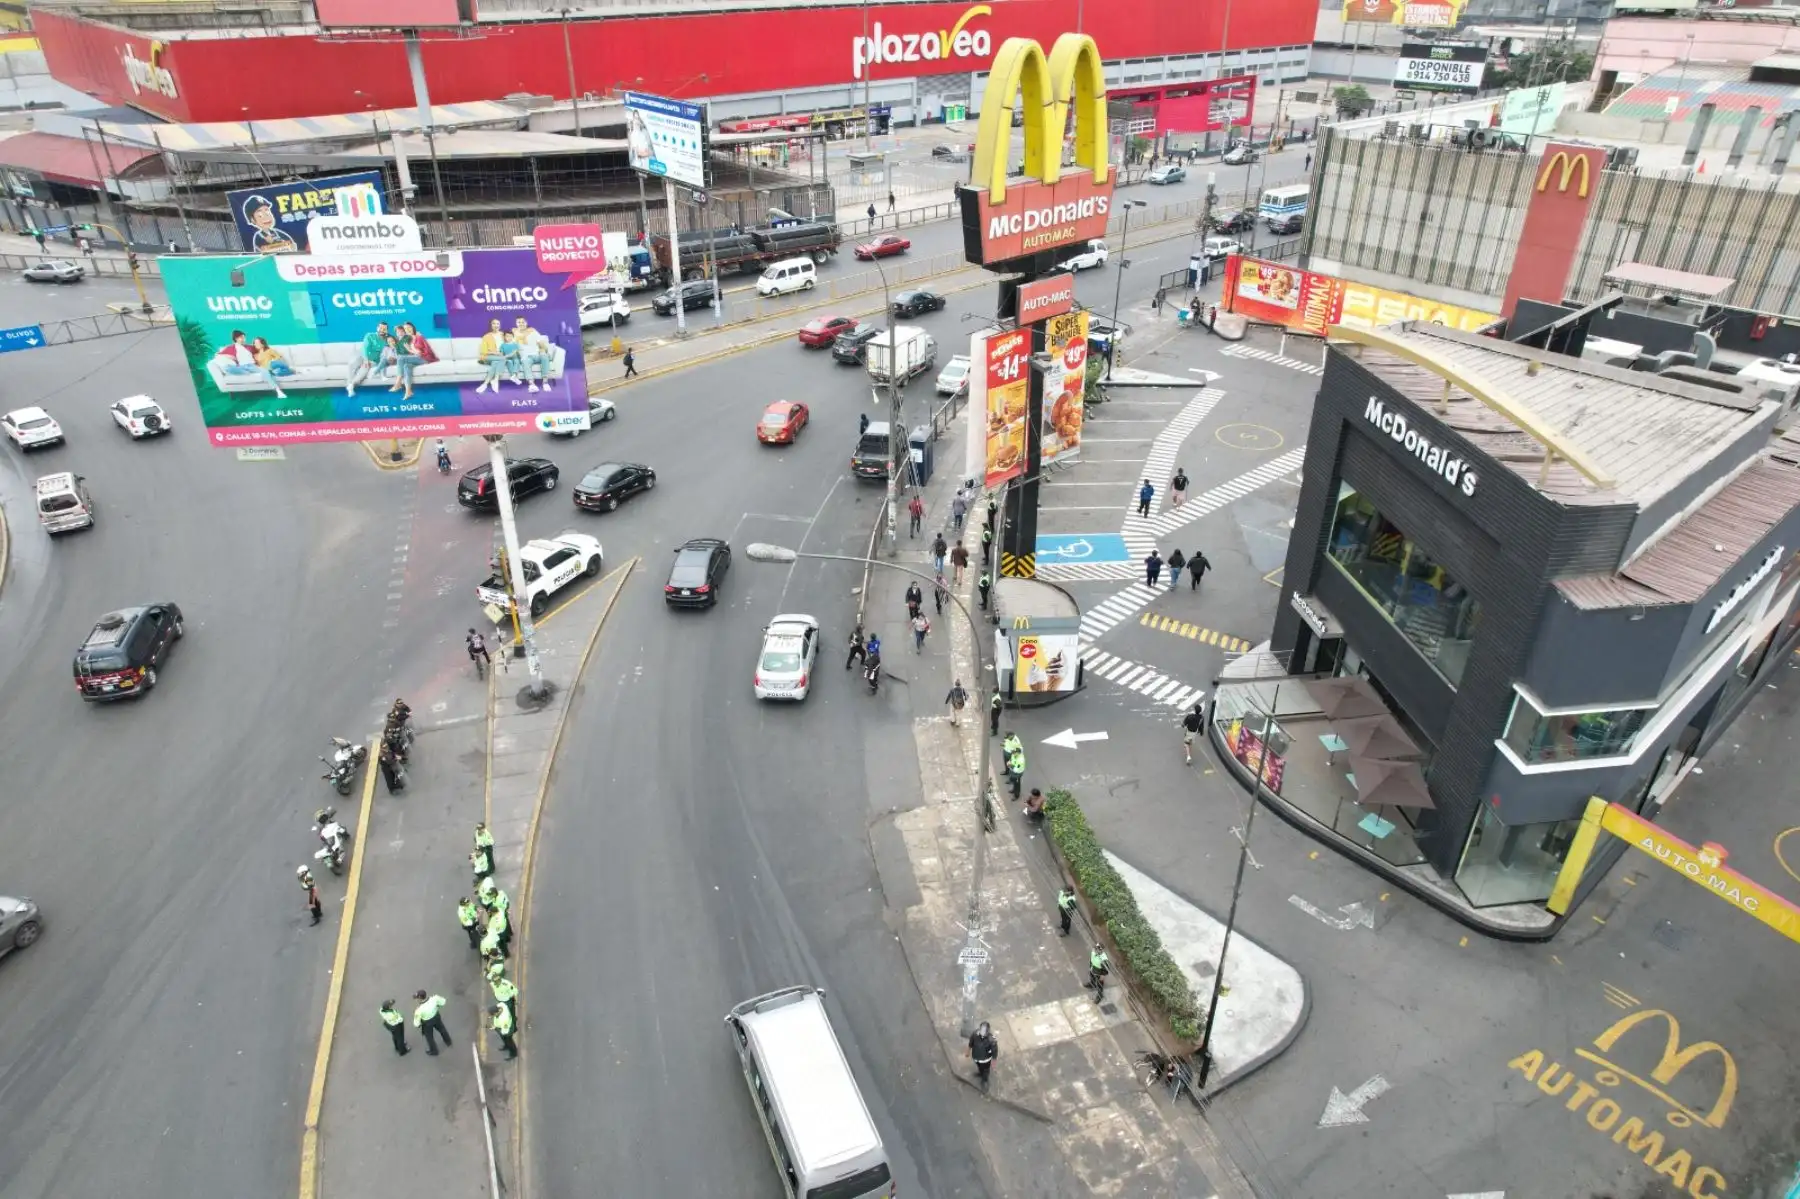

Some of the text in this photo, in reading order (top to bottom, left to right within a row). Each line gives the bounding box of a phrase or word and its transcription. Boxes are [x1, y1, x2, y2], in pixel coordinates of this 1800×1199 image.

[1409, 60, 1472, 74] DISPONIBLE
[1413, 71, 1431, 80] 914
[1433, 72, 1450, 82] 750
[989, 196, 1108, 239] McDonald's
[321, 220, 405, 240] mambo
[1023, 226, 1076, 249] AUTOMAC
[539, 235, 598, 250] NUEVO
[541, 250, 599, 262] PROYECTO
[295, 263, 345, 278] Depas
[350, 261, 385, 276] para
[206, 295, 273, 312] unno
[332, 288, 424, 309] cuattro
[472, 284, 548, 304] cinnco
[1023, 290, 1071, 311] AUTO-MAC
[1303, 276, 1331, 333] AUTOMAC
[362, 405, 389, 413] FLATS
[1364, 395, 1478, 496] McDonald's
[1640, 837, 1760, 911] AUTO-MAC
[1506, 1048, 1728, 1199] AUTOMAC
